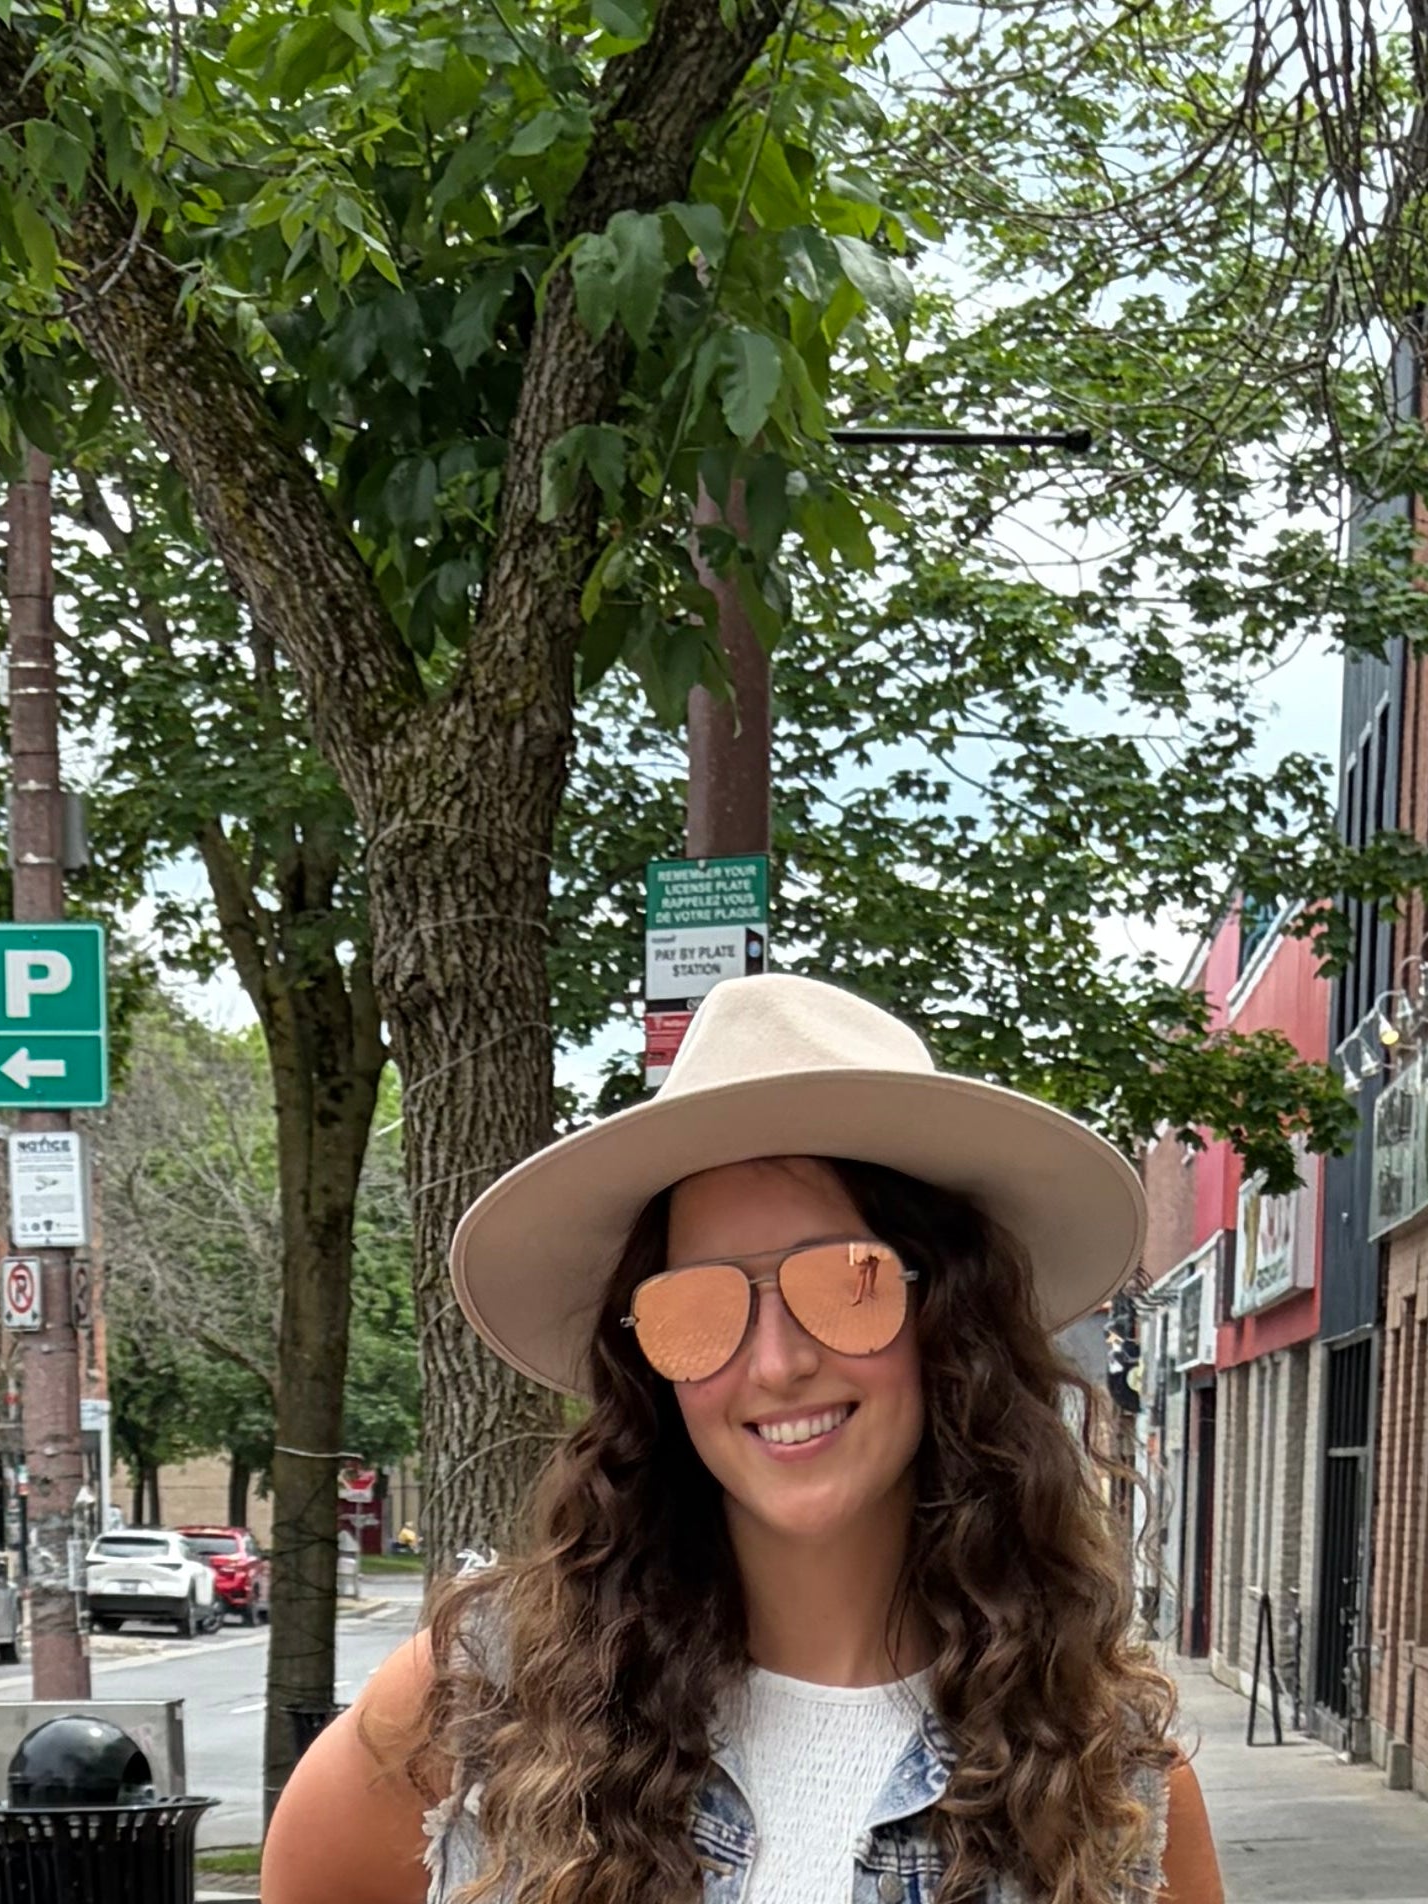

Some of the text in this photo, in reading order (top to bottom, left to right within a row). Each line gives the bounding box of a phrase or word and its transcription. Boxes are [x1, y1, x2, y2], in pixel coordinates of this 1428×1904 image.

[723, 864, 757, 878] YOUR
[715, 878, 751, 892] PLATE
[722, 892, 756, 906] VOUS
[673, 908, 712, 922] VOTRE
[714, 905, 761, 920] PLAQUE
[655, 944, 736, 961] PAY BY PLATE
[672, 962, 722, 977] STATION
[3, 949, 73, 1019] P
[16, 1139, 72, 1153] NOTICE
